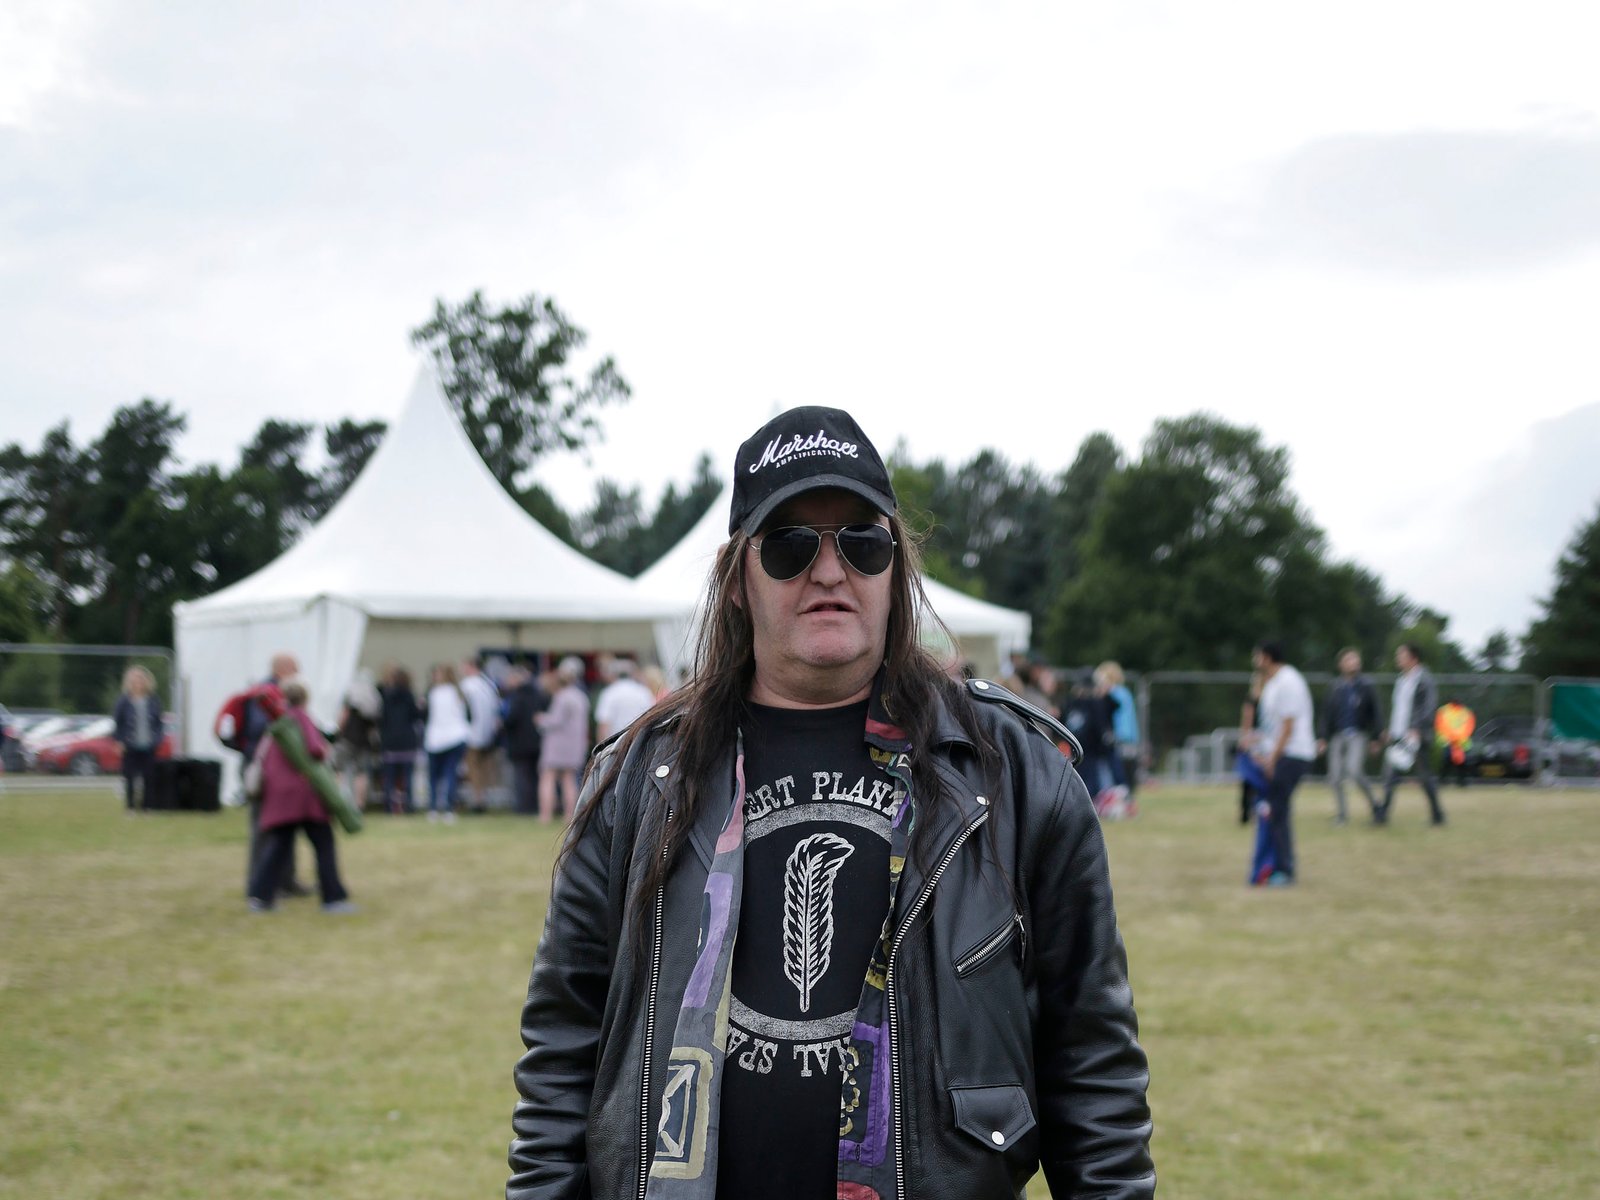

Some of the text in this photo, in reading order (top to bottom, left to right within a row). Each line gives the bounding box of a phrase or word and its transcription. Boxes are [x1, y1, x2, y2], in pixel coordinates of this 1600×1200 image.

[749, 430, 858, 473] Marshall
[776, 450, 841, 468] AMPLIFICATION
[744, 775, 795, 821] ERT
